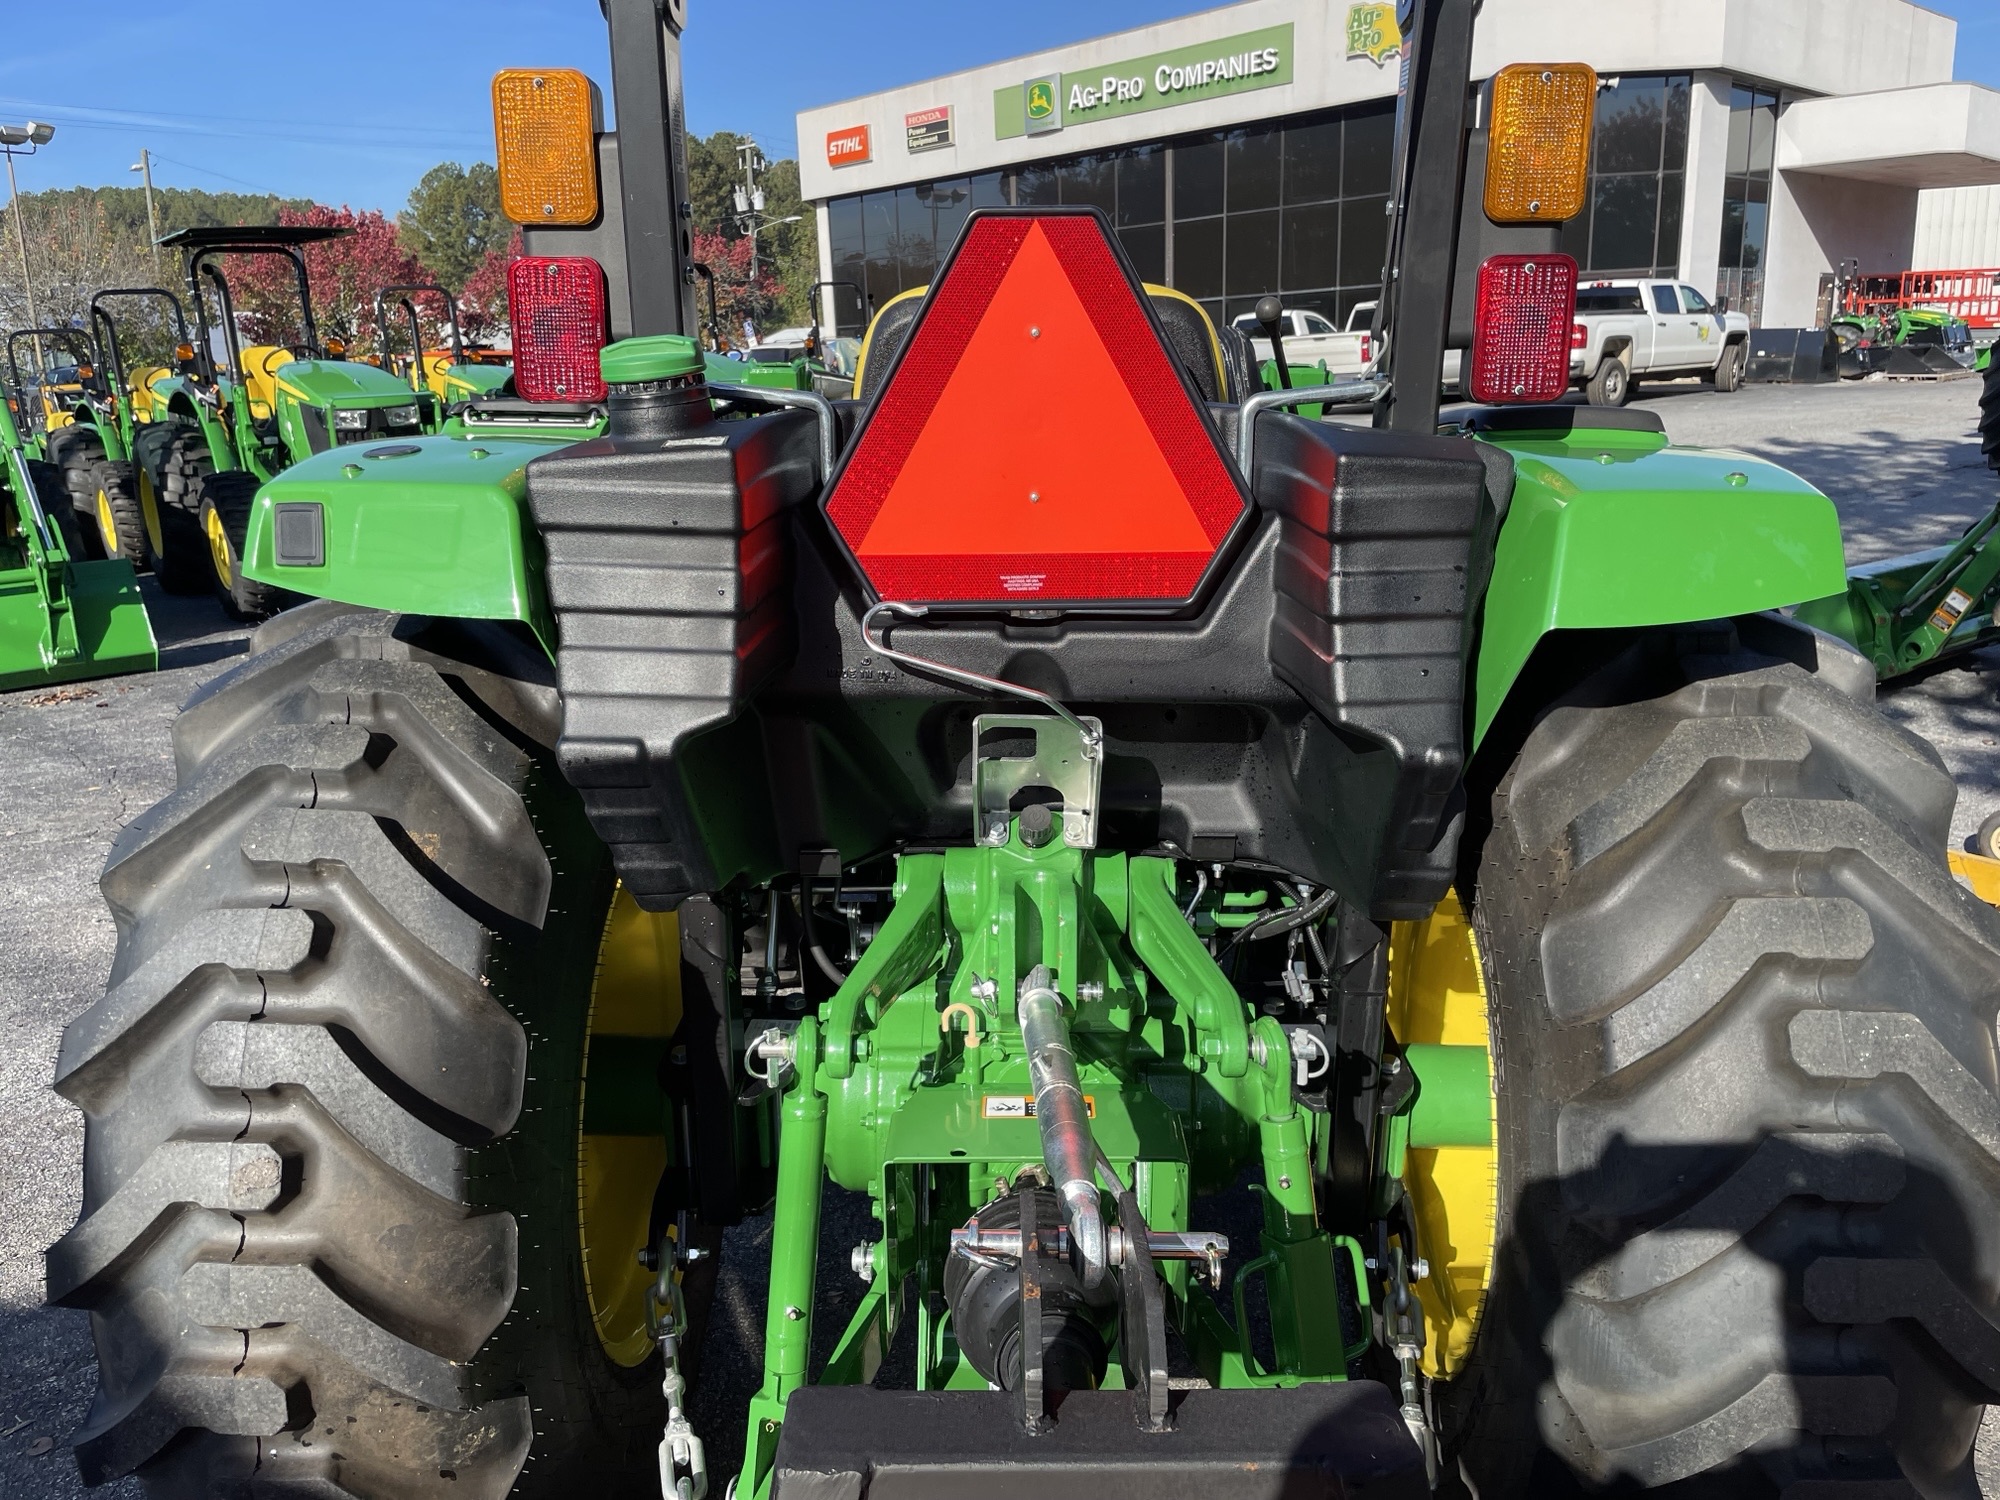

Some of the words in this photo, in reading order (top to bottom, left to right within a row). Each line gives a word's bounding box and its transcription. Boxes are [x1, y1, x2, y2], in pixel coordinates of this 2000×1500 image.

[1348, 6, 1383, 32] Ag-
[1348, 29, 1383, 53] Pro
[908, 111, 941, 125] HONDA
[908, 127, 927, 137] Power
[829, 136, 863, 157] STIHL
[909, 134, 939, 148] Equipment
